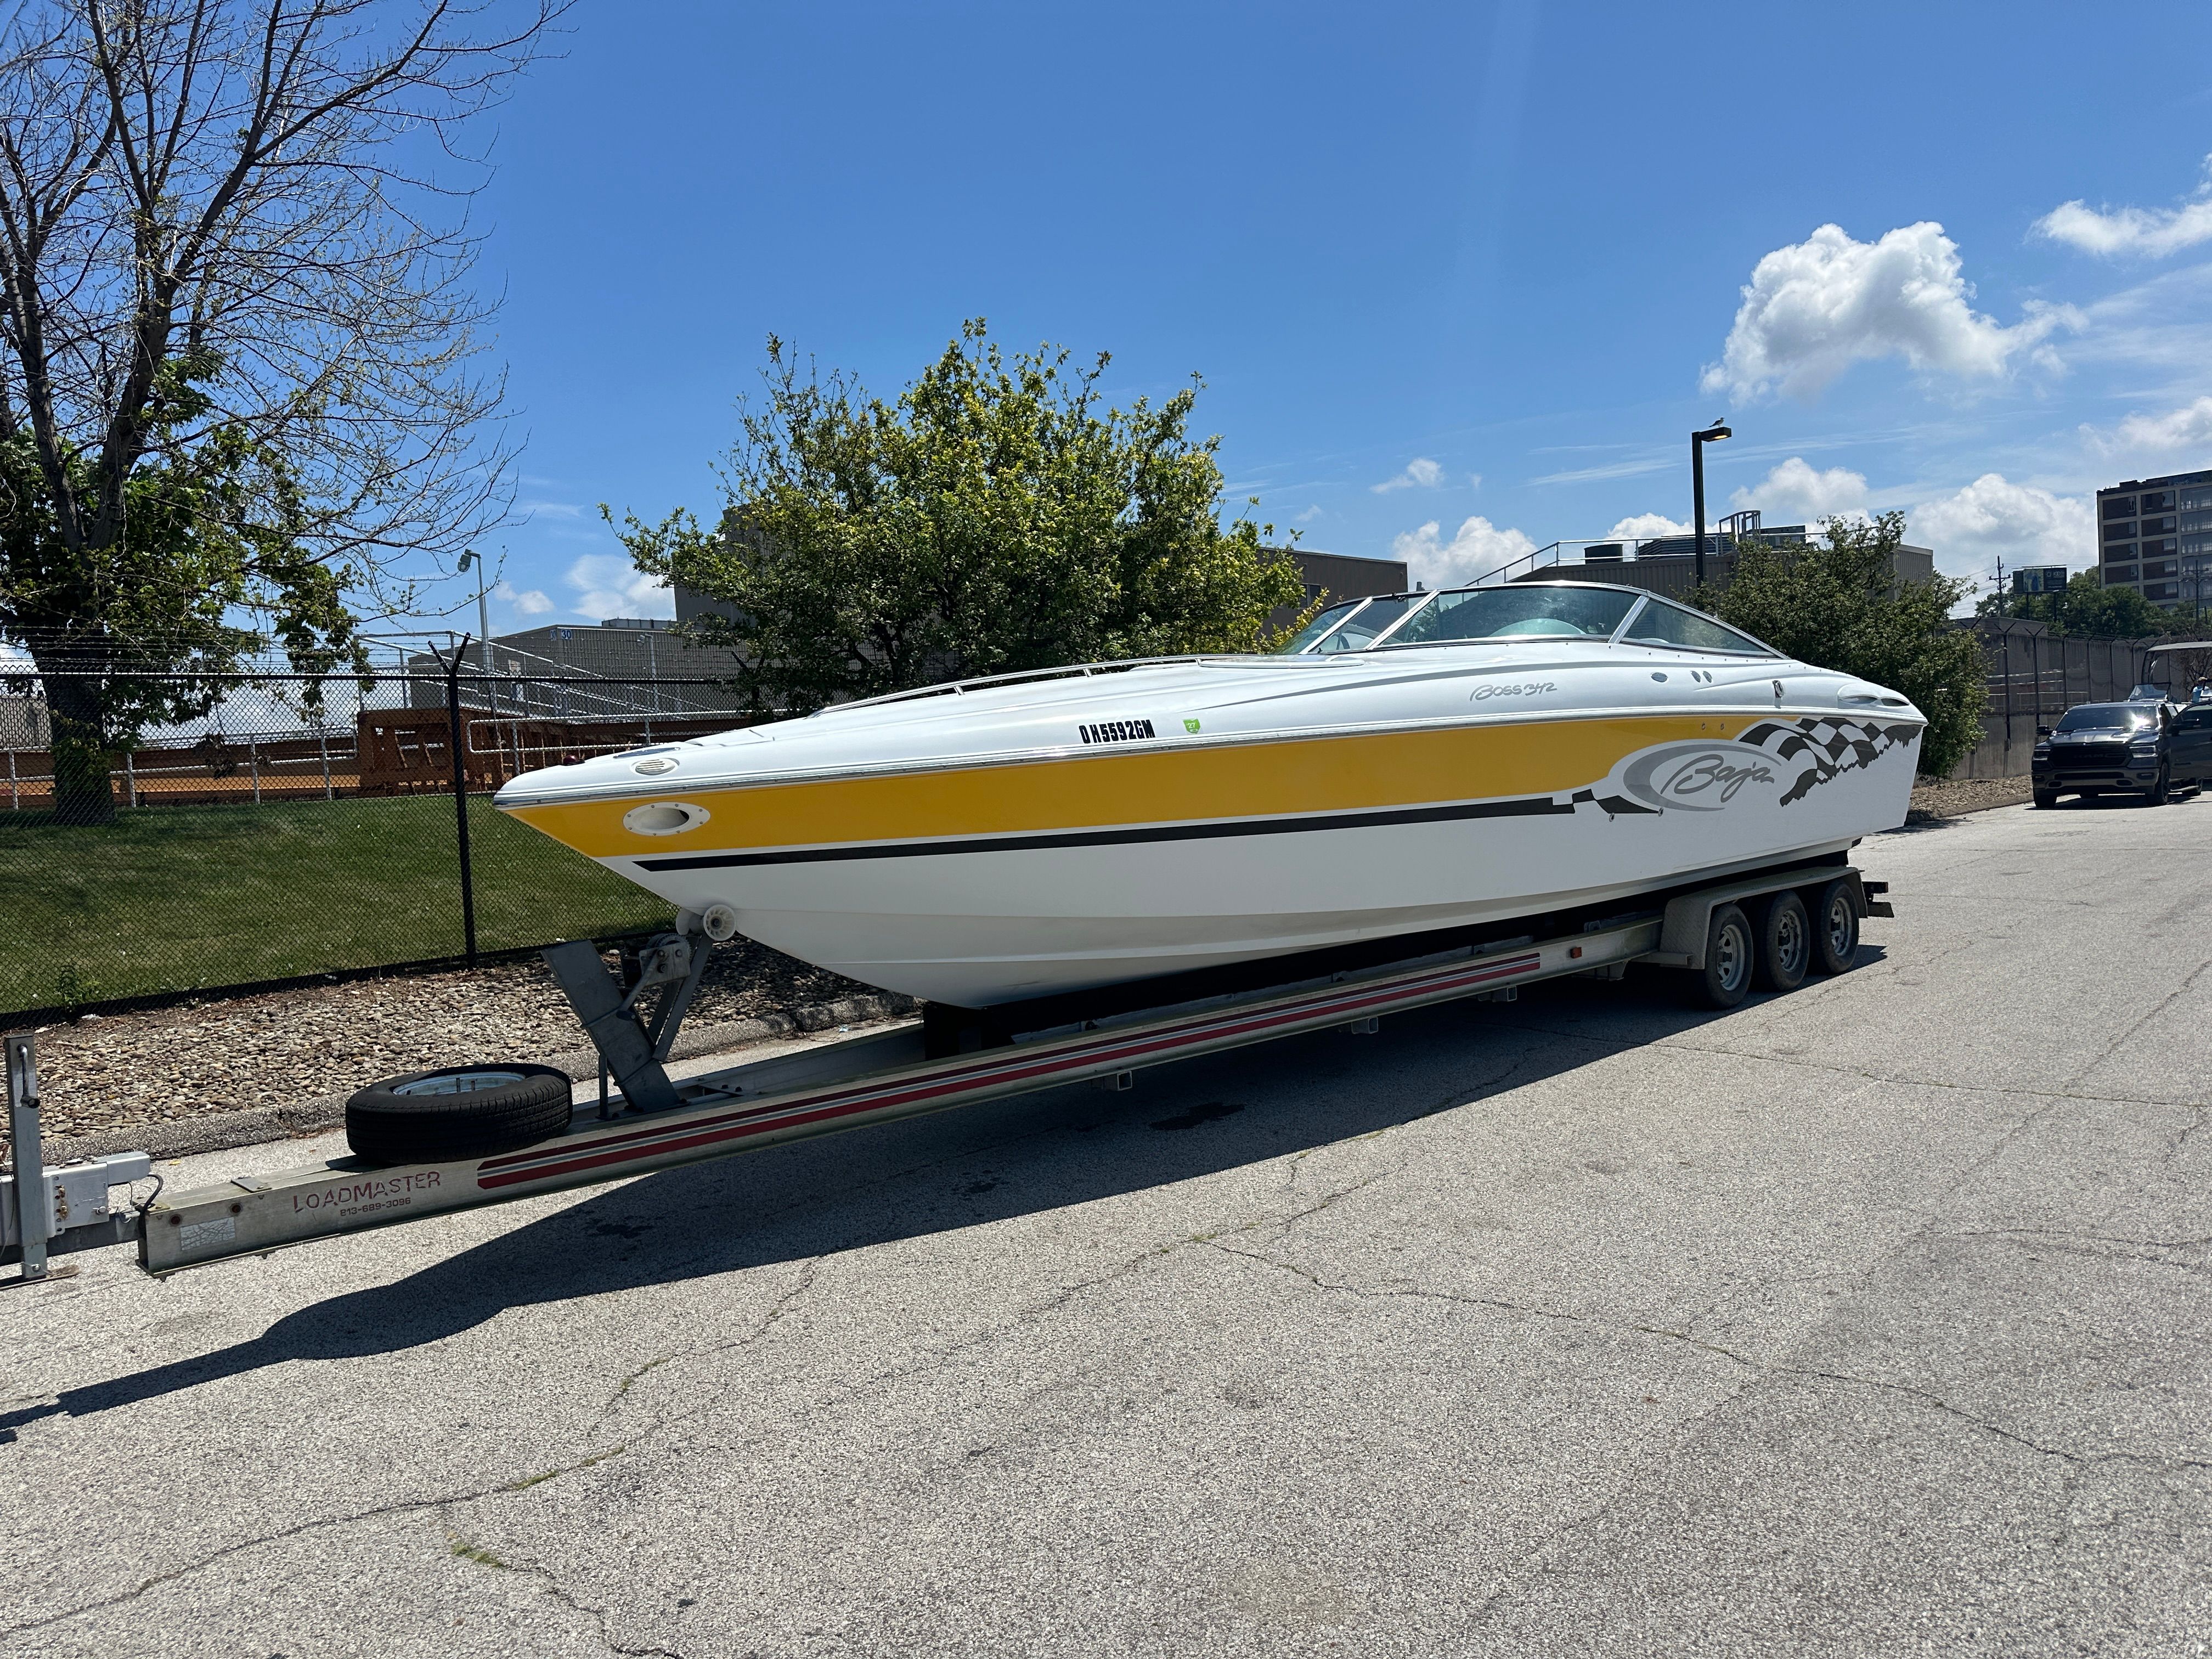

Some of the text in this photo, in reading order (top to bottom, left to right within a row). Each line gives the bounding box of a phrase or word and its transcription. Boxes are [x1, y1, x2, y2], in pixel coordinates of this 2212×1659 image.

[561, 630, 571, 639] 30
[1523, 682, 1558, 696] 342
[1660, 754, 1775, 803] Baja
[293, 1171, 441, 1213] LOADMASTER
[340, 1197, 411, 1216] 813-689-3096
